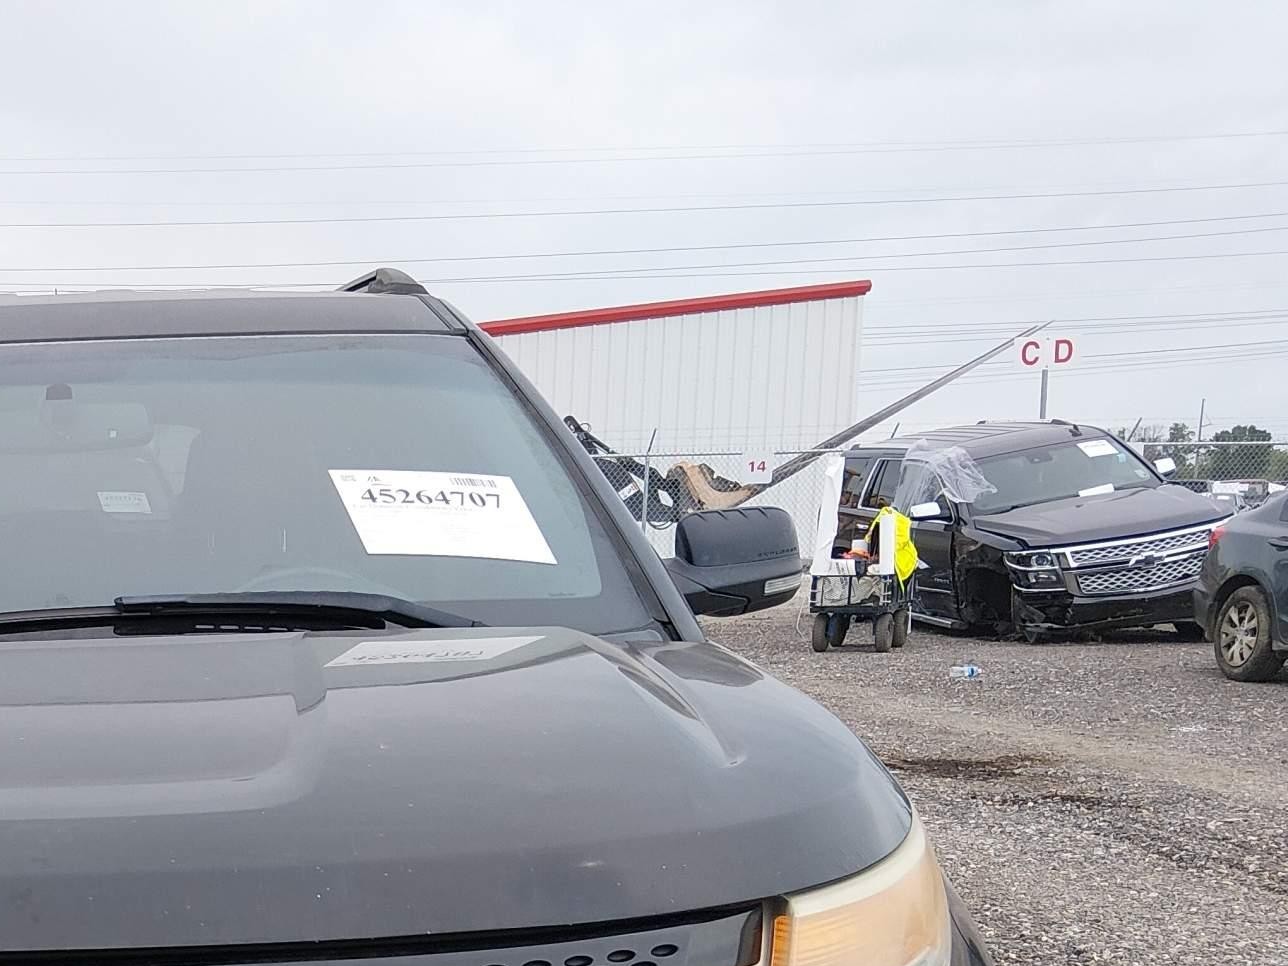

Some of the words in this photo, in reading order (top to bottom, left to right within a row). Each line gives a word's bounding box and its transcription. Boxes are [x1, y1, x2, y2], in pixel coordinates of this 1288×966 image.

[1021, 340, 1040, 366] C
[1054, 339, 1073, 363] D
[748, 461, 767, 473] 14
[360, 488, 501, 509] 45264707
